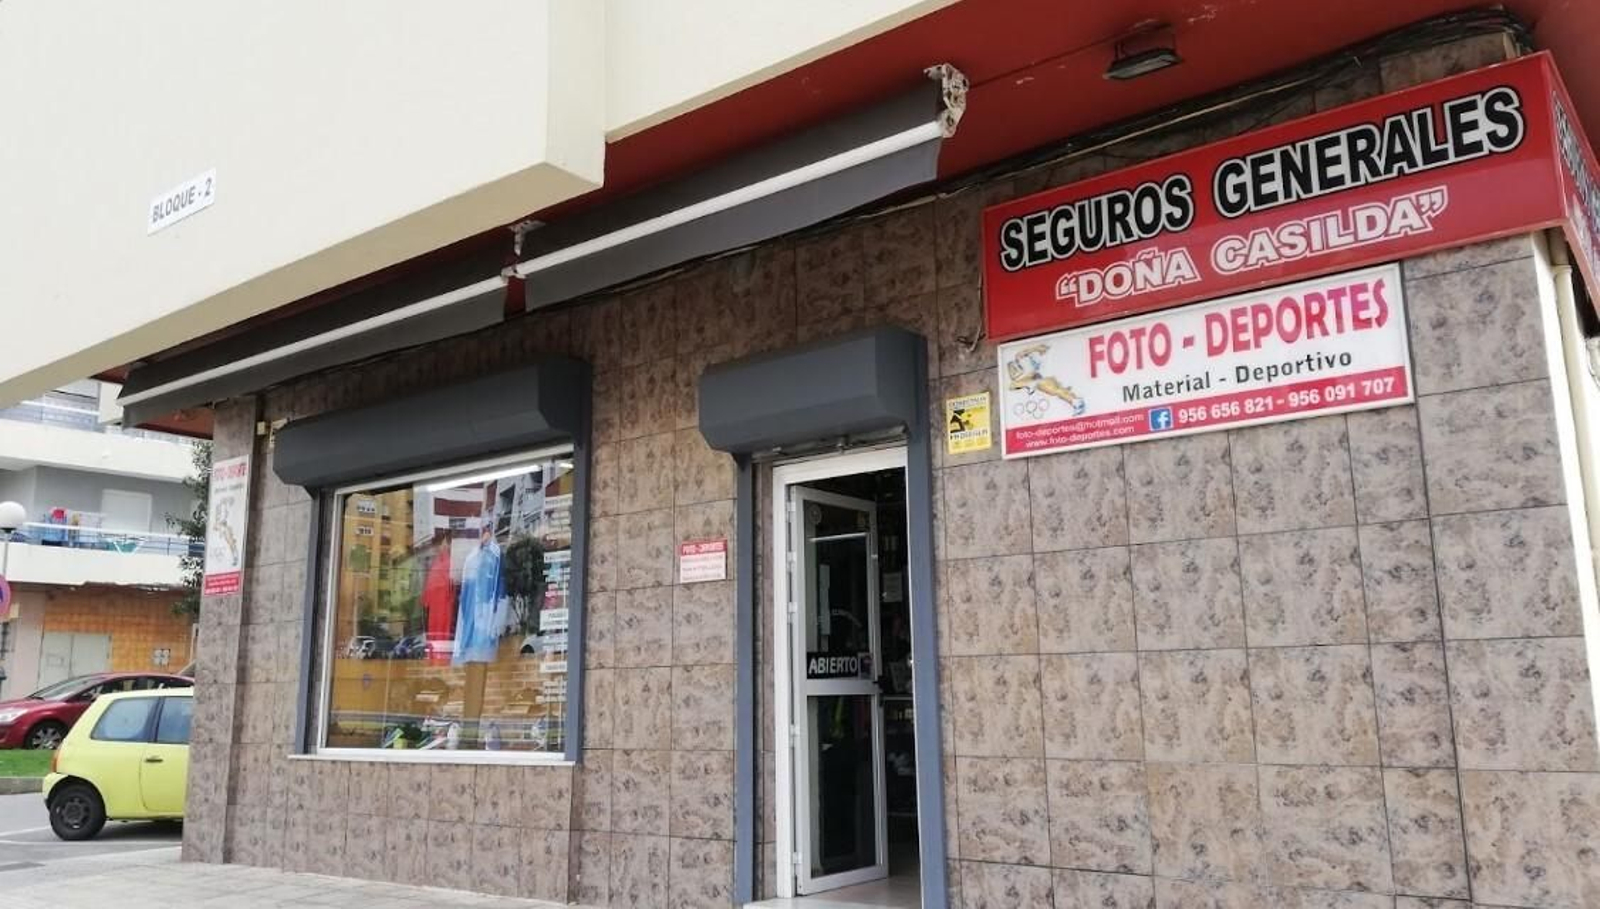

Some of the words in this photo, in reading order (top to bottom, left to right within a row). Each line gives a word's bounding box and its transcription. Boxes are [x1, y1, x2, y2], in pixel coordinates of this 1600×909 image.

[152, 185, 196, 223] BLOQUE
[205, 177, 213, 197] 2
[1000, 174, 1195, 272] SEGUROS
[1212, 87, 1526, 219] GENERALES
[1088, 322, 1172, 379] FOTO
[1204, 278, 1389, 358] DEPORTES
[1122, 371, 1211, 402] Material
[1235, 351, 1353, 384] Deportivo
[1178, 405, 1207, 423] 956
[1211, 400, 1240, 419] 656
[1245, 395, 1274, 414] 821
[1288, 388, 1320, 408] 956
[1324, 383, 1356, 402] 091
[1361, 376, 1396, 396] 707
[808, 656, 859, 674] ABIERTO
